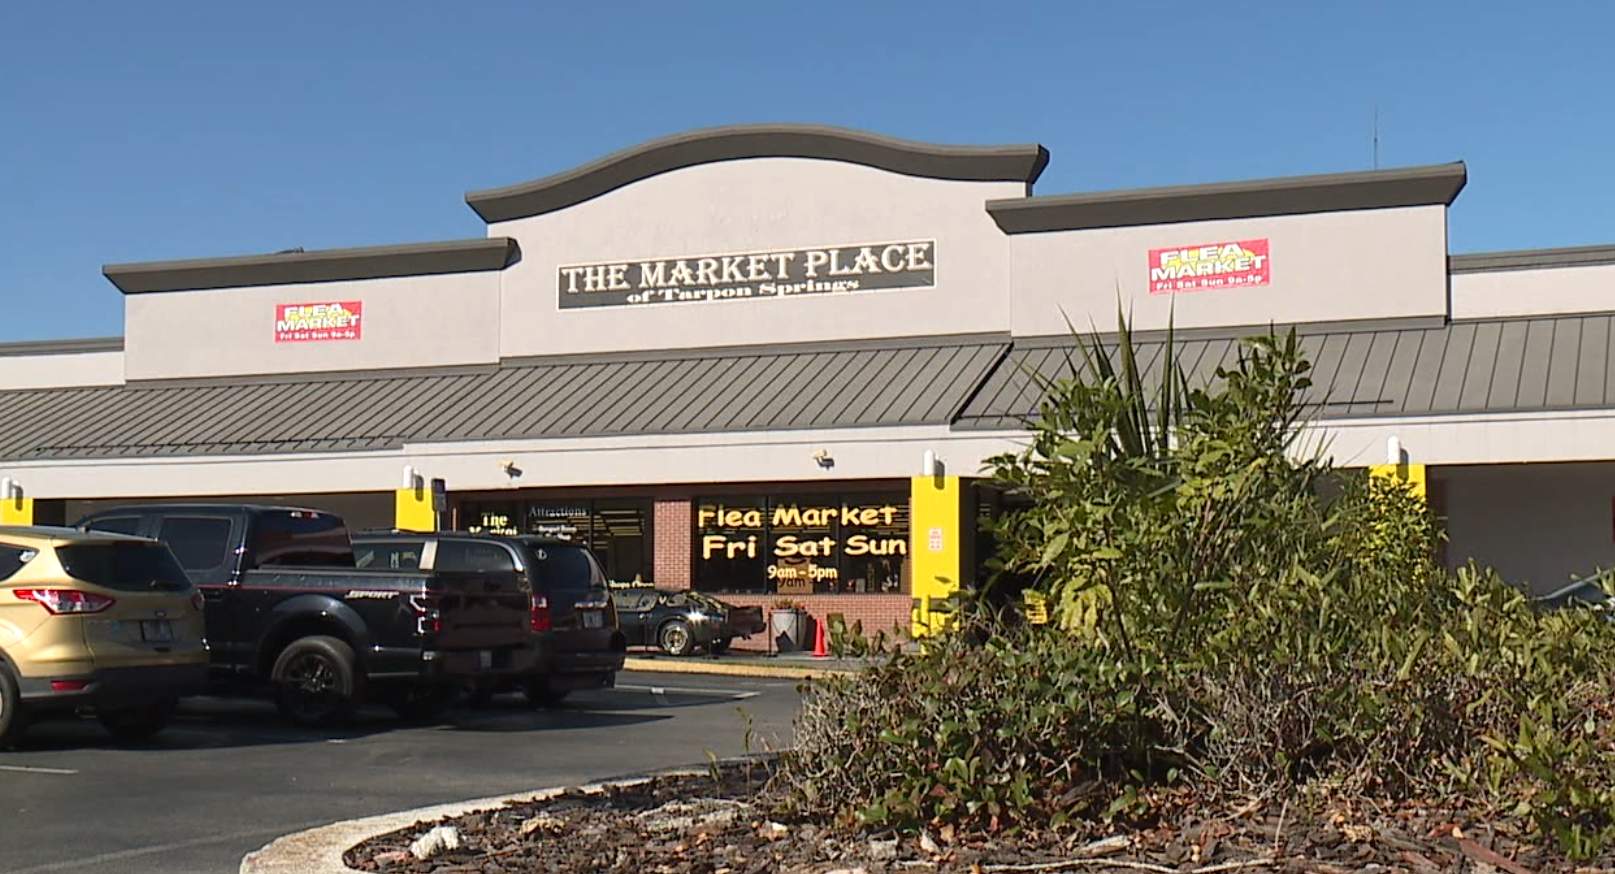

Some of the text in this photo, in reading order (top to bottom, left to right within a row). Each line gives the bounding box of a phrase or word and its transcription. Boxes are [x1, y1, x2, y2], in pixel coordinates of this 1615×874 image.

[1160, 243, 1244, 265] FLEA
[561, 242, 933, 293] THE MARKET PLACE
[1151, 255, 1266, 281] MARKET
[626, 279, 860, 304] of Tarpon Springs
[1156, 282, 1172, 290] Fri
[1177, 280, 1196, 289] Sat
[1201, 278, 1223, 287] Sun
[284, 303, 343, 318] FLEA
[277, 314, 360, 332] MARKET
[280, 332, 292, 340] Fri
[294, 331, 309, 340] Sat
[312, 330, 329, 339] Sun
[481, 511, 508, 527] The
[529, 506, 587, 518] Attractions
[698, 503, 898, 528] Flea Market
[702, 535, 757, 560] Fri
[773, 535, 836, 557] Sat
[844, 535, 907, 556] Sun
[767, 564, 797, 579] 9am
[808, 564, 838, 582] 5pm
[344, 590, 400, 600] SPORT
